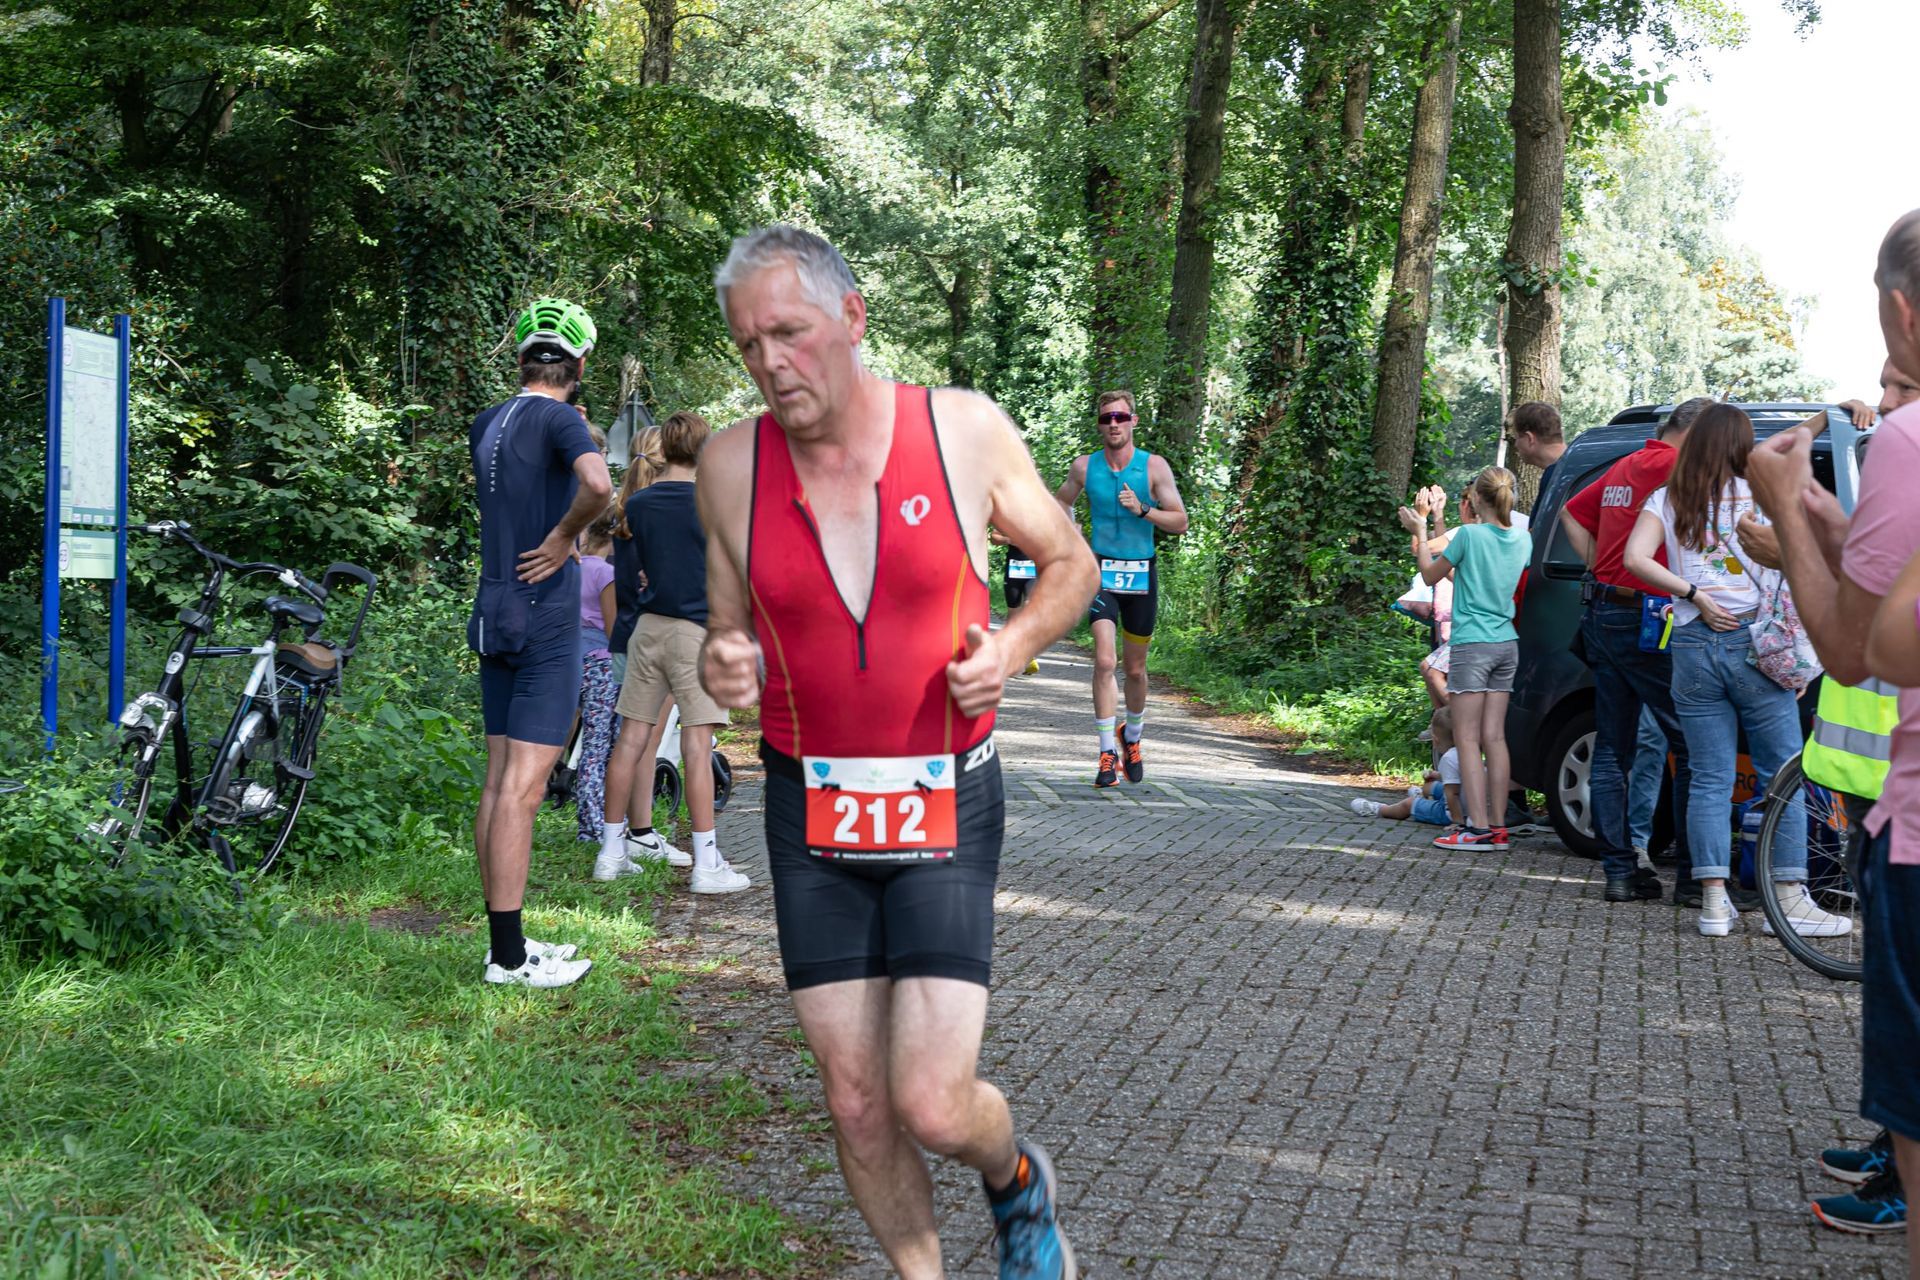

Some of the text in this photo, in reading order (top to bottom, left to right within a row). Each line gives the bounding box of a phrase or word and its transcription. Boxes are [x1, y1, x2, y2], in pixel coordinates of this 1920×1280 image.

[1601, 486, 1632, 507] EHBO
[1114, 573, 1135, 588] 57
[833, 795, 927, 845] 212
